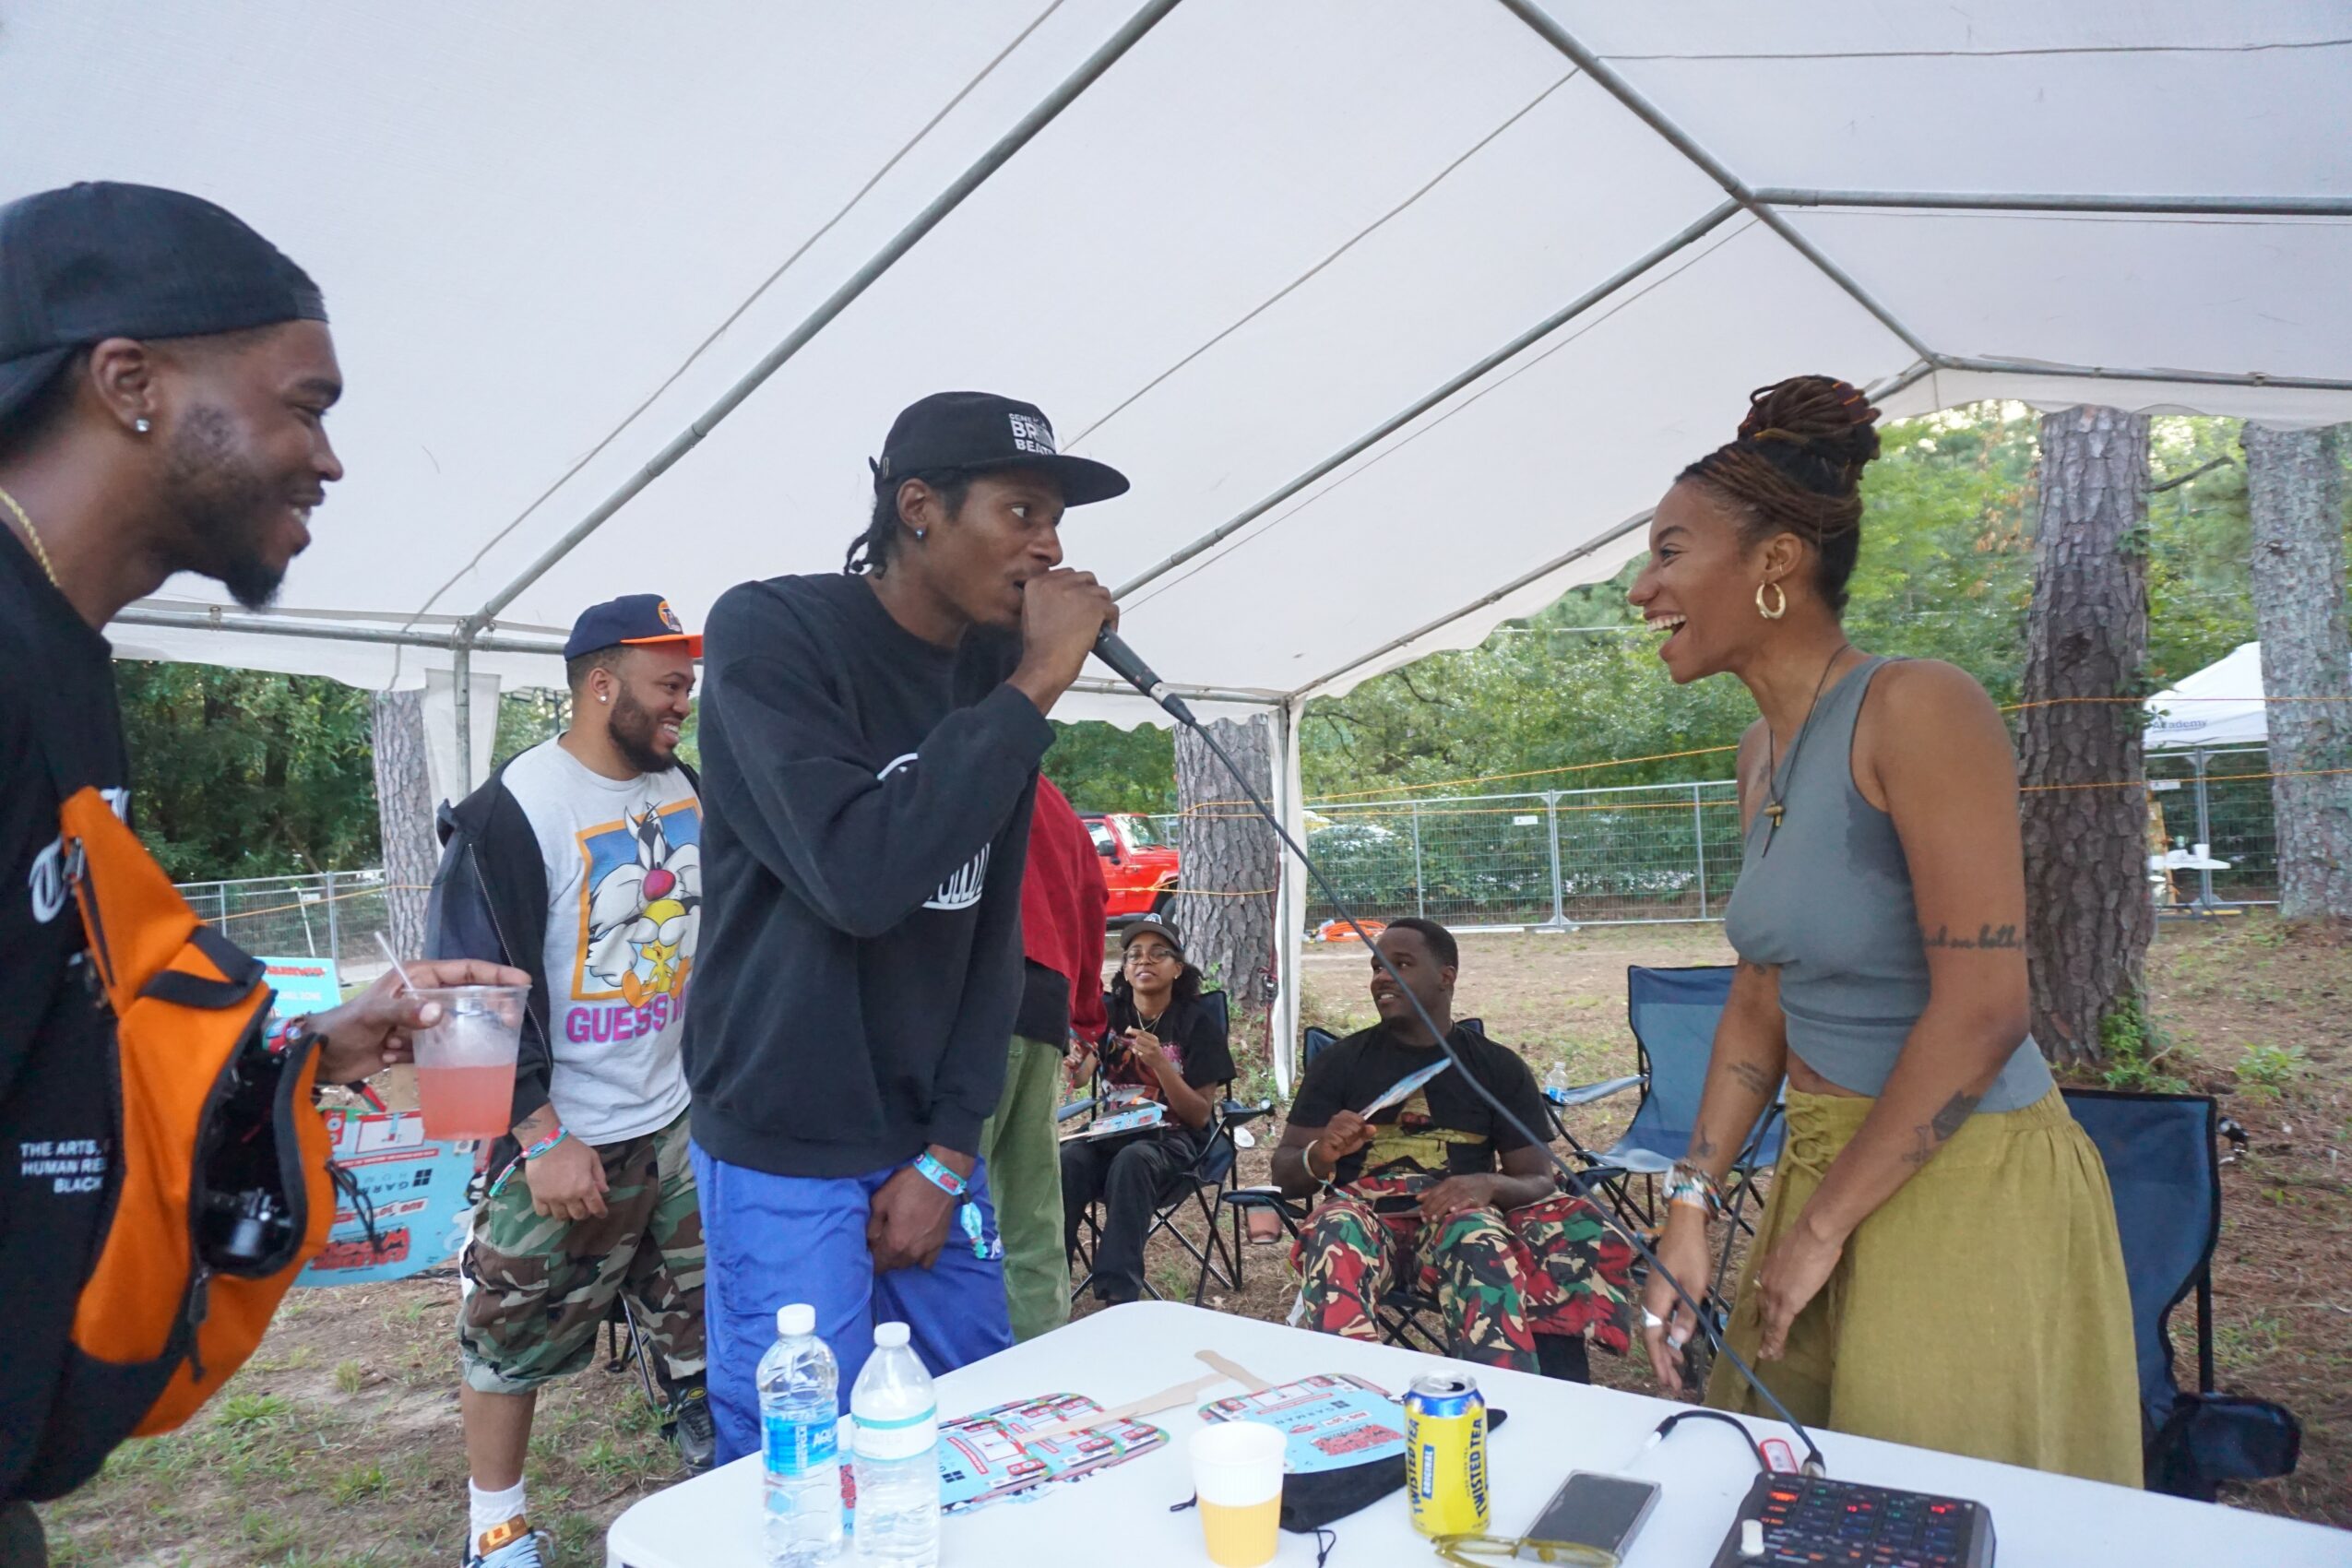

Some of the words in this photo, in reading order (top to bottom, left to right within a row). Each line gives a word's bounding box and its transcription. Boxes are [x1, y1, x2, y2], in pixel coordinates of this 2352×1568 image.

[565, 992, 669, 1043] GUESS
[20, 1141, 53, 1157] THE
[22, 1159, 78, 1176] HUMAN
[813, 1423, 837, 1448] AQU
[1408, 1419, 1420, 1445] TEA
[1470, 1418, 1483, 1448] TEA
[1408, 1445, 1424, 1515] TWISTED
[1469, 1448, 1488, 1518] TWISTED
